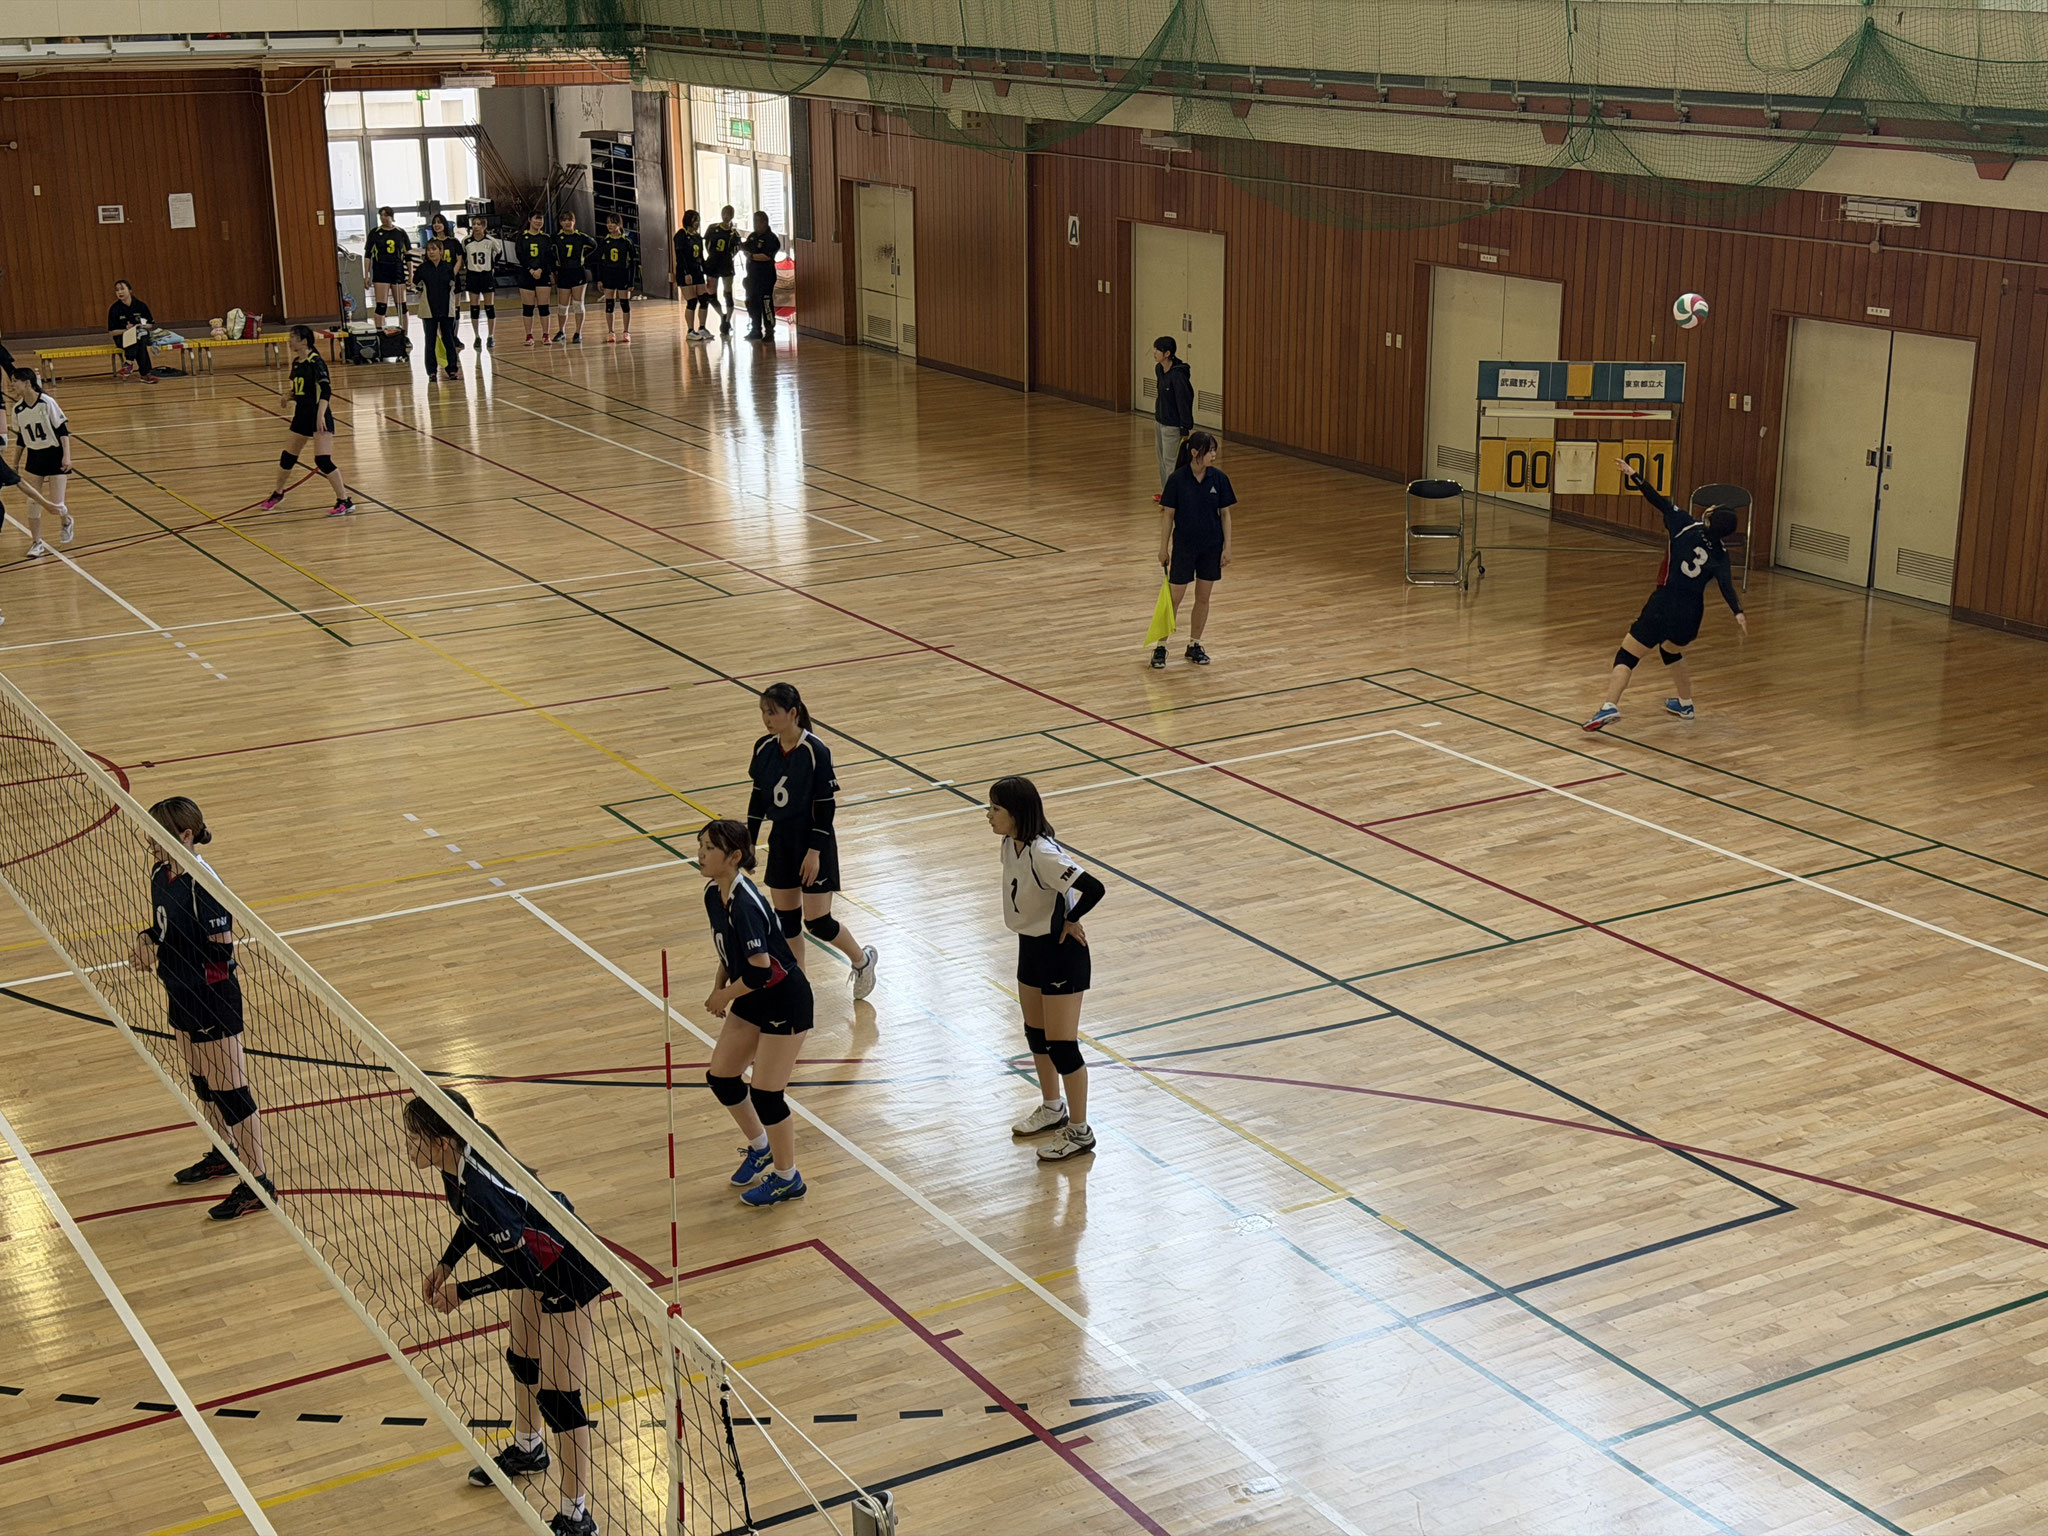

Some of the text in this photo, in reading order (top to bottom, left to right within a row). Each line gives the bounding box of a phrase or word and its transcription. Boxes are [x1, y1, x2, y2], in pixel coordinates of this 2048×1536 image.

[1069, 219, 1079, 243] A
[386, 239, 396, 254] 3
[530, 243, 539, 257] 5
[565, 244, 573, 258] 7
[715, 238, 726, 252] 9
[471, 251, 486, 265] 13
[610, 247, 619, 262] 6
[294, 376, 305, 396] 12
[1500, 377, 1537, 388] 武蔵野大
[1624, 380, 1664, 388] 東京都立大
[24, 422, 47, 442] 14
[1506, 450, 1551, 488] 00
[1681, 546, 1709, 579] 3
[773, 775, 789, 808] 6
[1011, 877, 1020, 914] 1
[156, 905, 168, 942] 9
